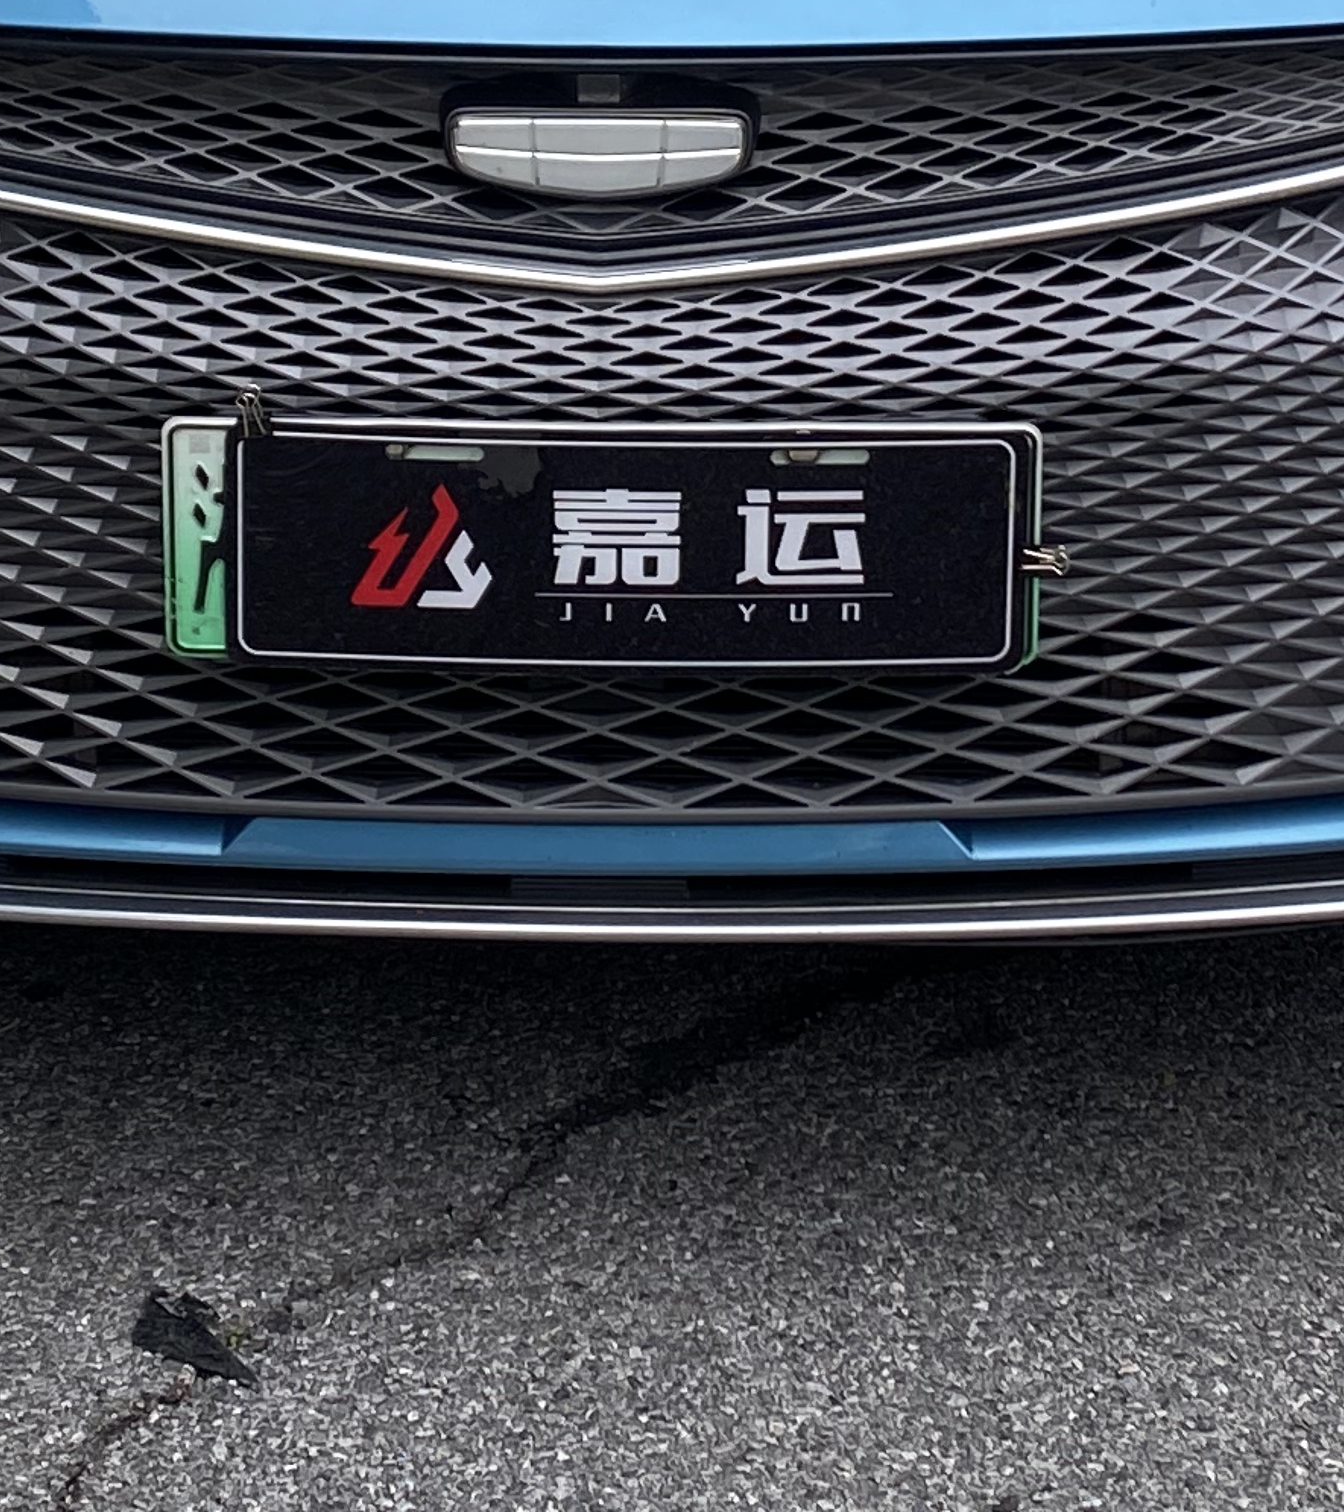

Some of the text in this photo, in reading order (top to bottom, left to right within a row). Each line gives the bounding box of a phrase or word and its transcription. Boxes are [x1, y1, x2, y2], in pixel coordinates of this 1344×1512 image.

[551, 488, 866, 586] 嘉运
[559, 602, 862, 623] JIA YUN
